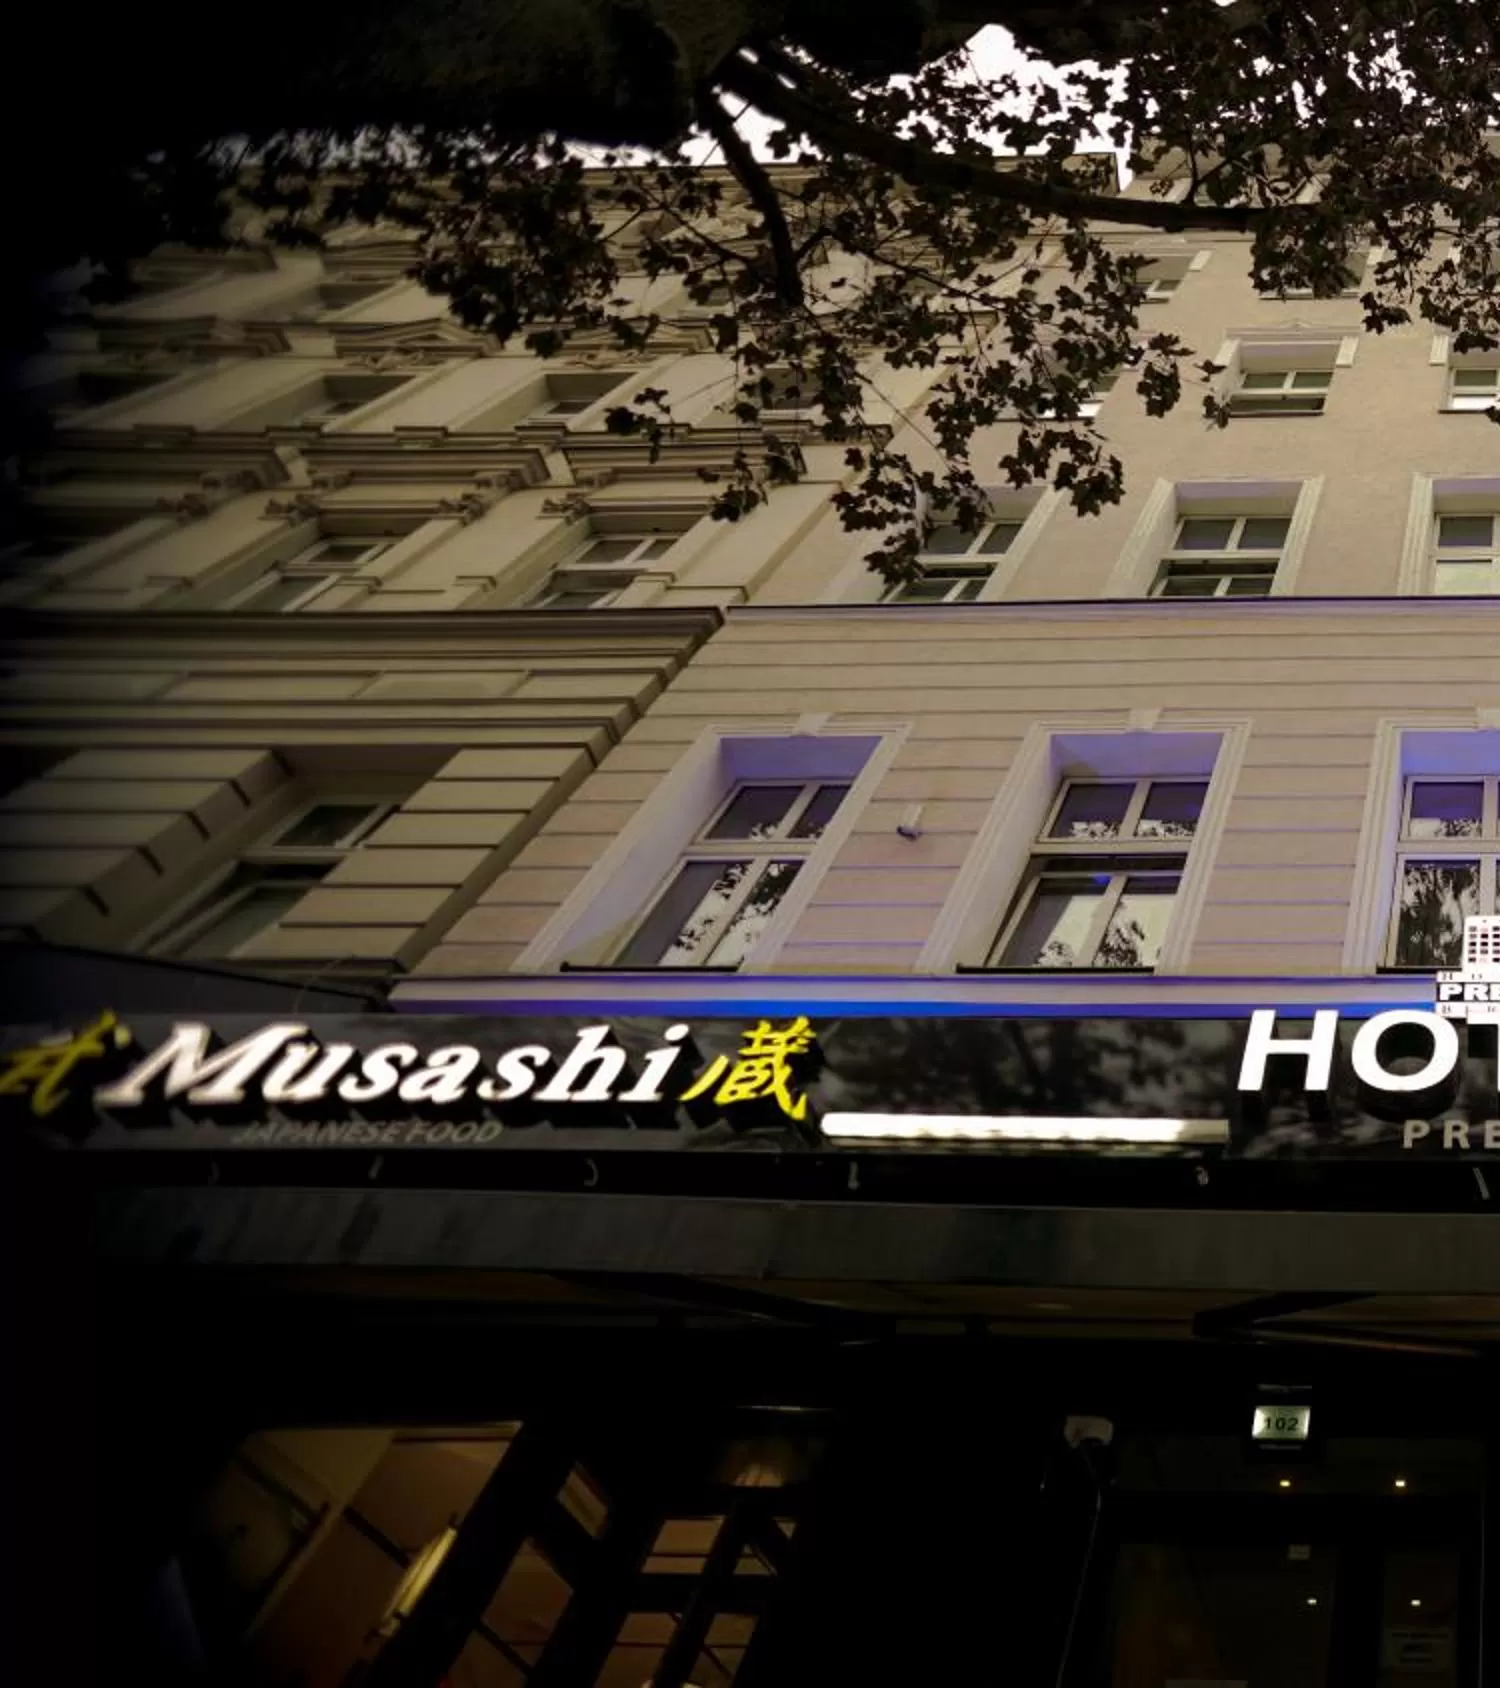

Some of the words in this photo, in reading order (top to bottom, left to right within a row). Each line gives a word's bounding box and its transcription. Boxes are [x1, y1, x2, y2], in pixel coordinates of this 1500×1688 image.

[92, 1023, 691, 1108] Musashi
[678, 1015, 816, 1120] 蔵
[232, 1119, 404, 1144] JAPANESE
[406, 1119, 503, 1144] FOOD
[1264, 1416, 1299, 1432] 102
